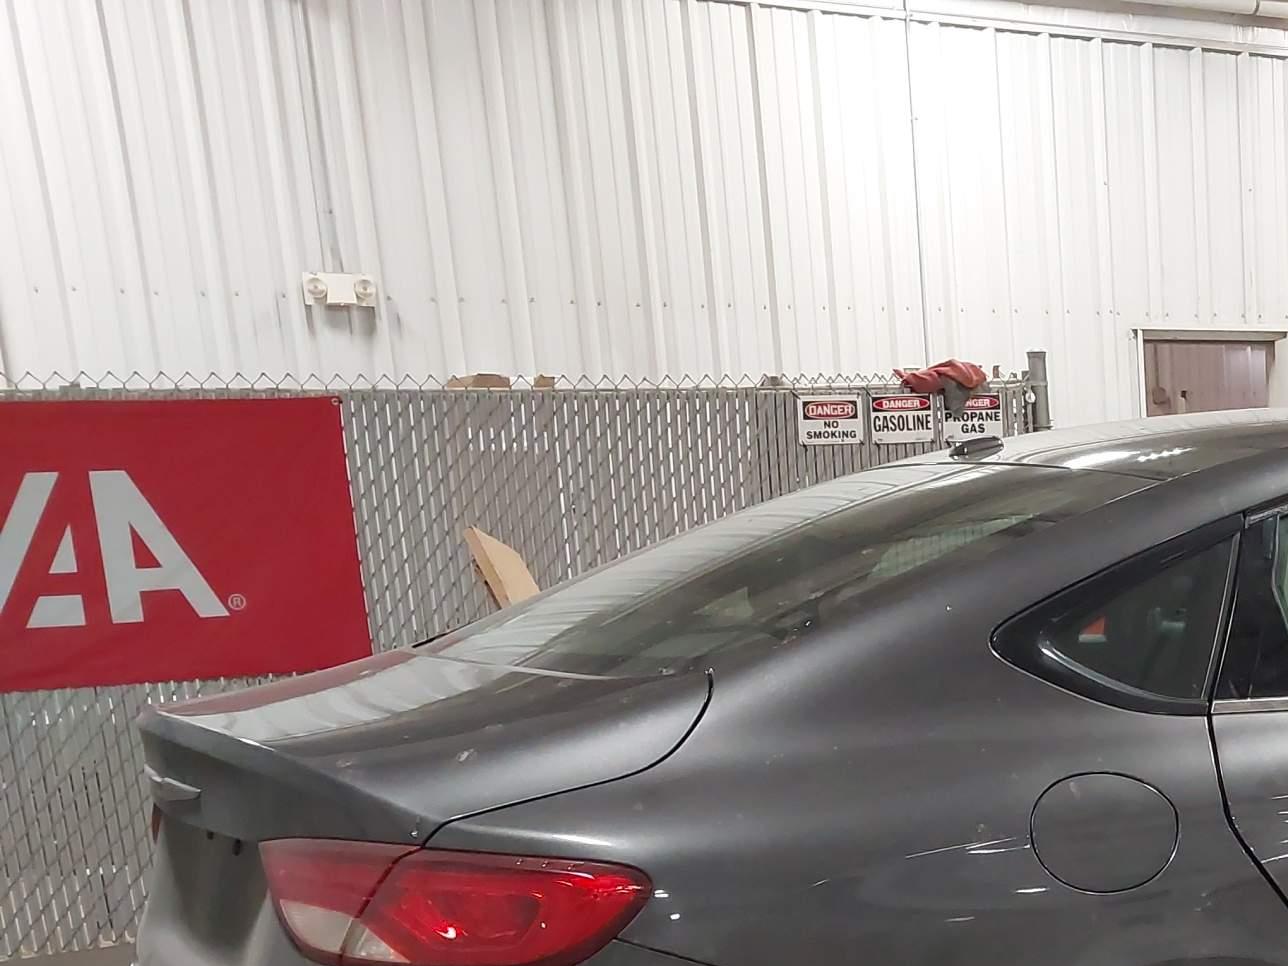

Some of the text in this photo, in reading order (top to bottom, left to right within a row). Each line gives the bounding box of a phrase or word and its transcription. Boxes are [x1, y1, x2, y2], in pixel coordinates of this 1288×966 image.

[882, 399, 921, 409] DANGER
[965, 398, 990, 408] NGER
[808, 403, 852, 416] DANGER
[823, 420, 839, 429] NO
[873, 413, 932, 433] GASOLINE
[961, 423, 985, 434] GAS
[806, 430, 857, 440] SMOKING
